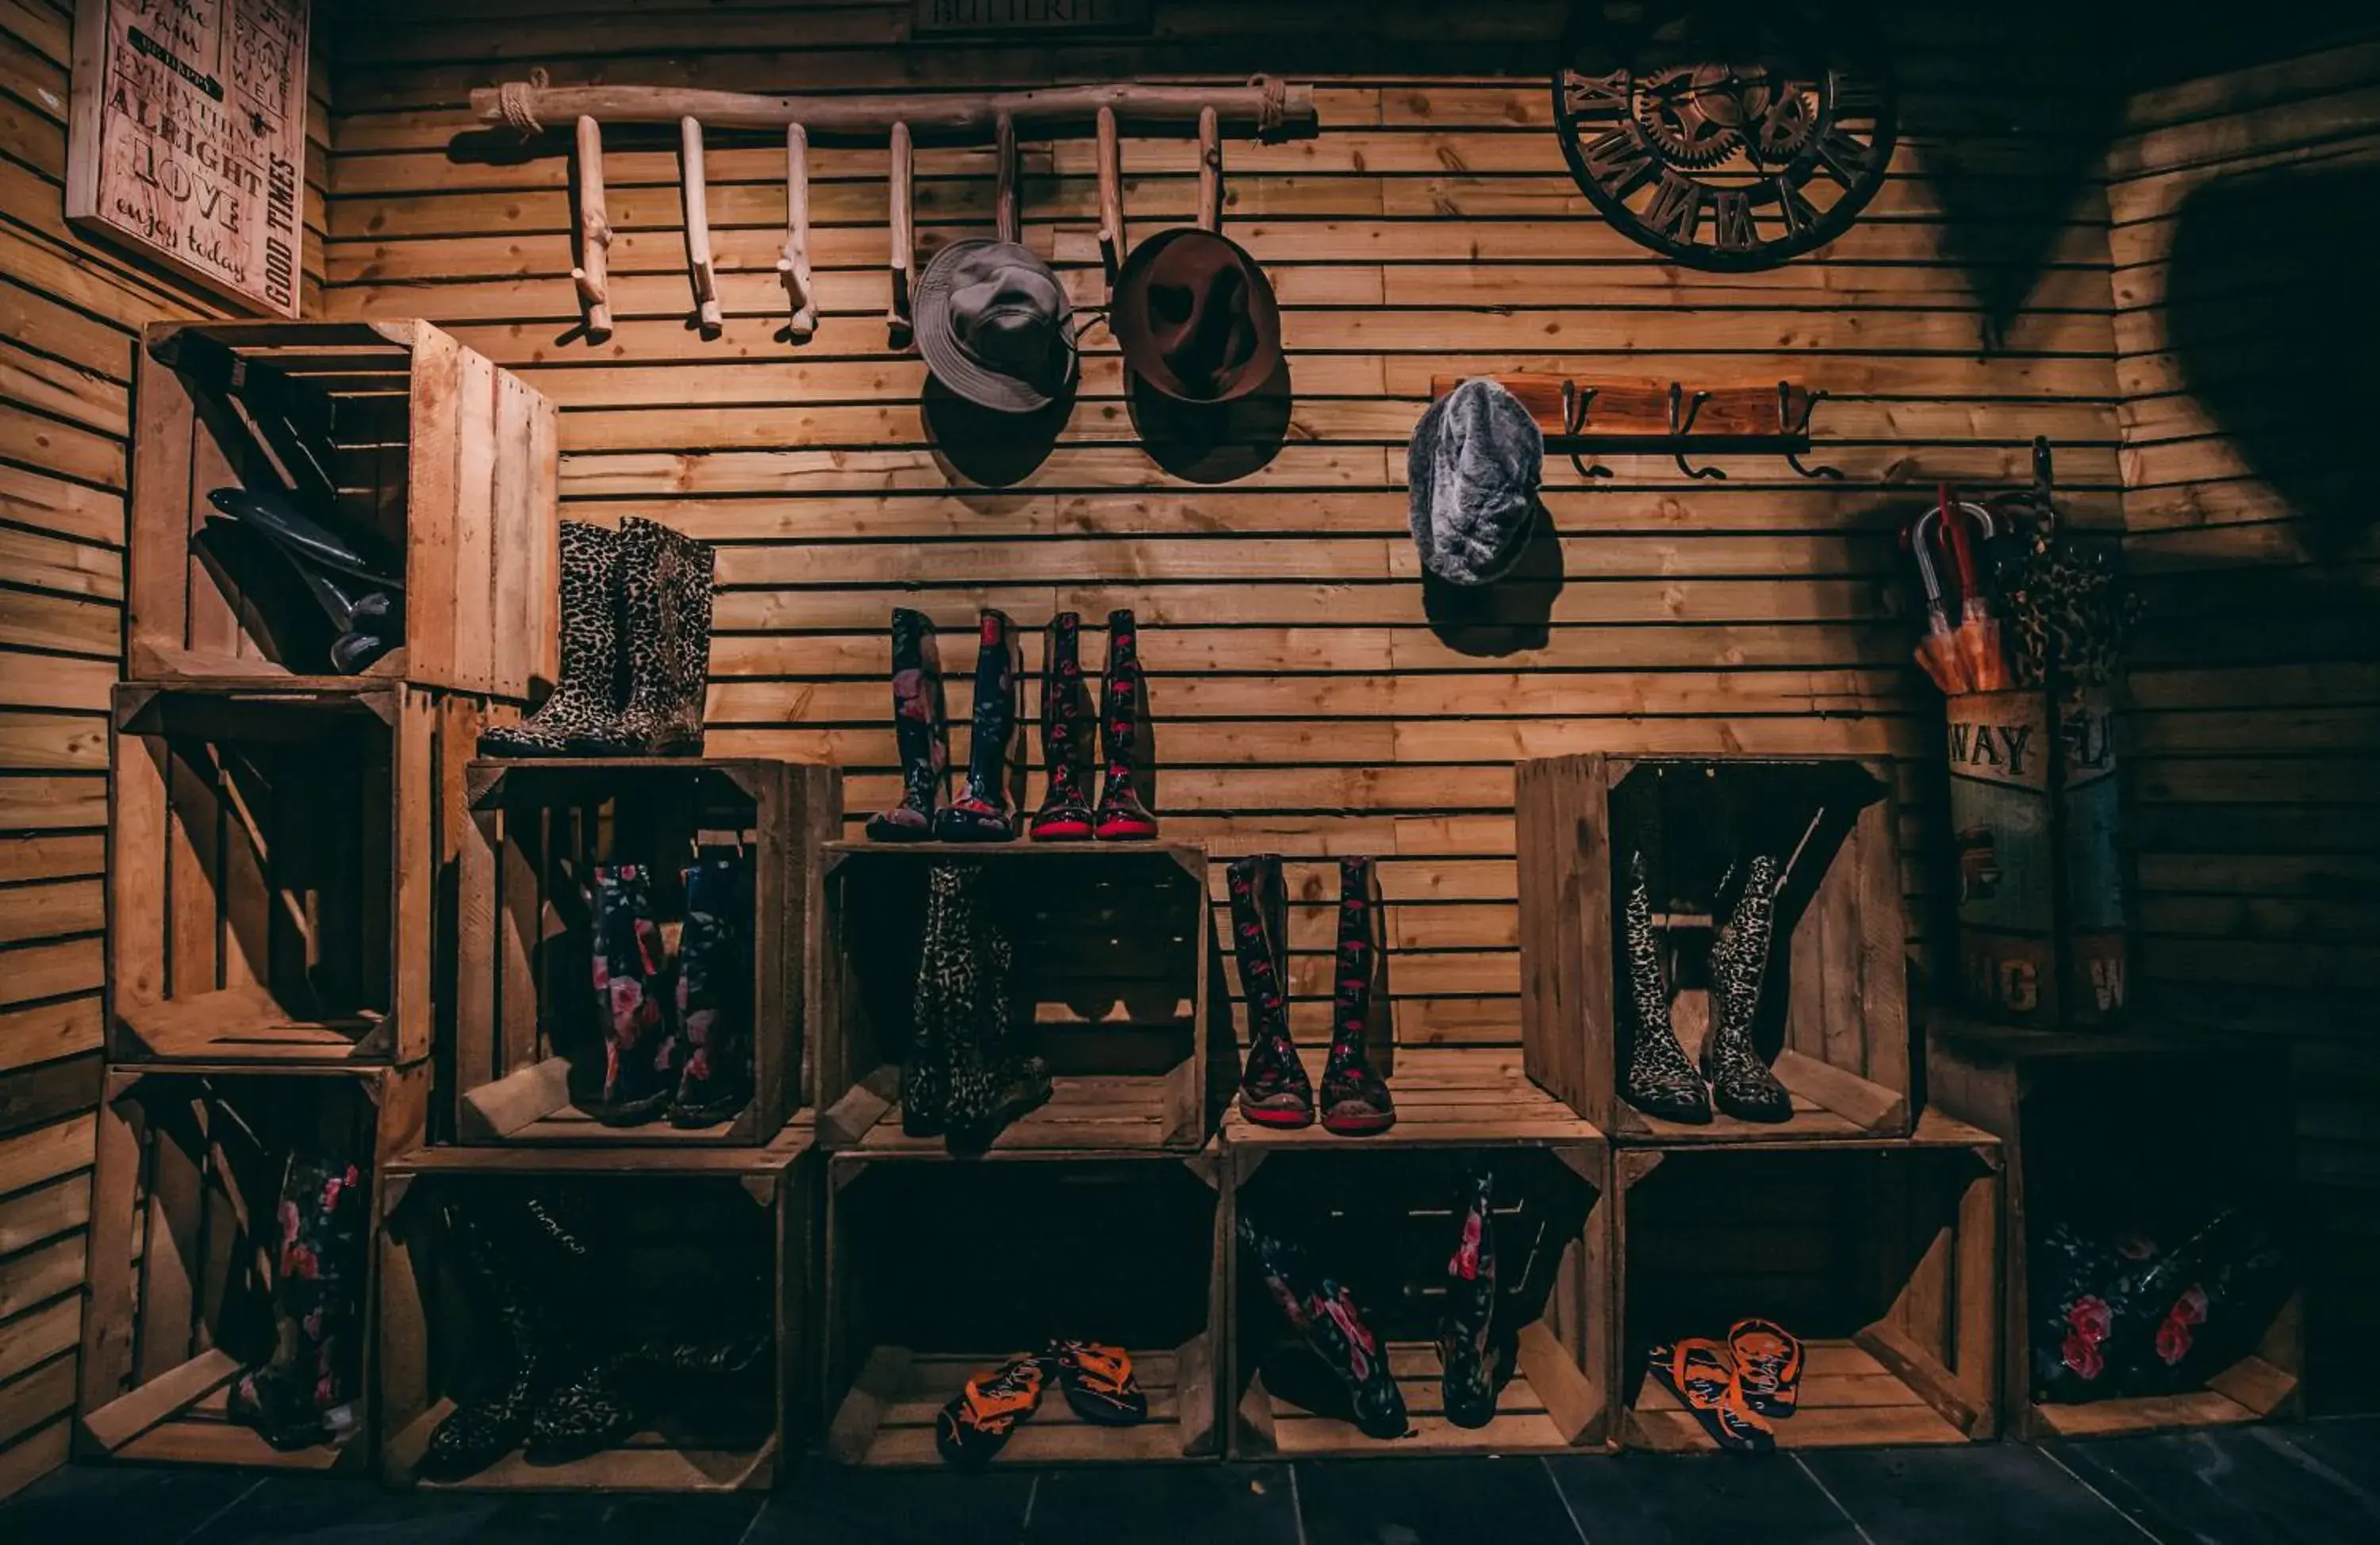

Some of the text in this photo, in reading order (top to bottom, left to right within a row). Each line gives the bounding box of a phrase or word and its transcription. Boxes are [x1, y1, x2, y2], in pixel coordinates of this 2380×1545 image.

[110, 88, 263, 197] ALRIGHT
[116, 46, 265, 159] EVERYTHING
[116, 196, 247, 284] enjoy today
[132, 138, 240, 236] LOVE
[265, 151, 295, 308] GOOD TIMES
